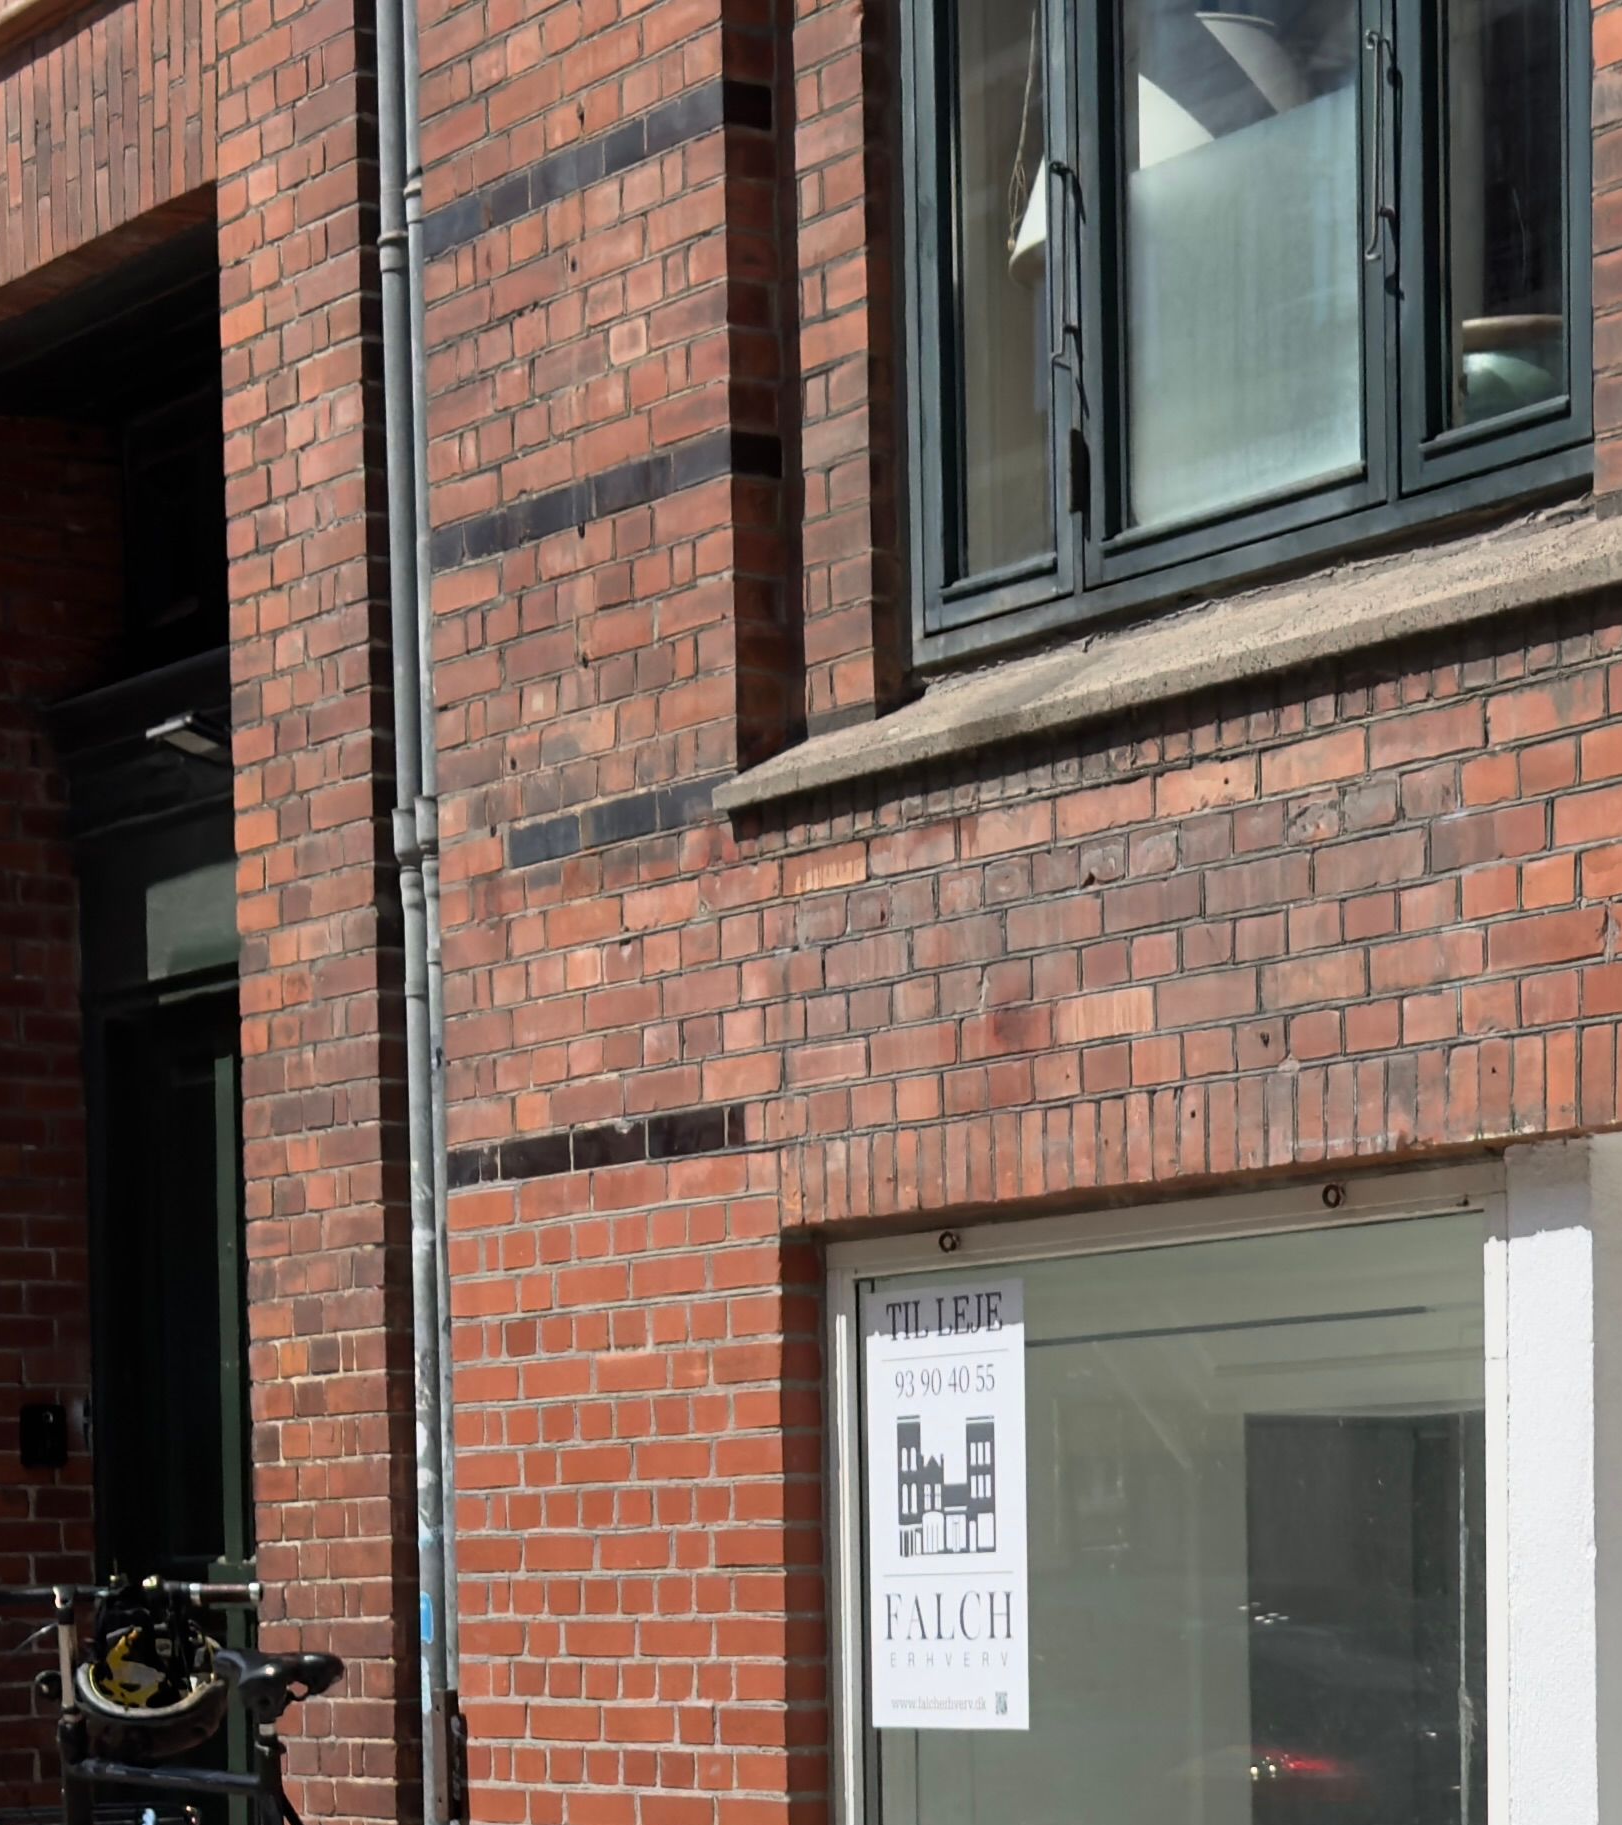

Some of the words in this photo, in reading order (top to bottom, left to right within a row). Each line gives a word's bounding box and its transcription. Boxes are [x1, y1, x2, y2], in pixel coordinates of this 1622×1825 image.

[886, 1300, 929, 1341] TIL
[934, 1292, 1004, 1336] LEJE
[895, 1370, 915, 1398] 93
[920, 1367, 942, 1397] 90
[947, 1365, 970, 1394] 40
[975, 1363, 996, 1392] 55
[885, 1590, 1014, 1641] FALCH
[890, 1651, 1009, 1668] ERHVERV
